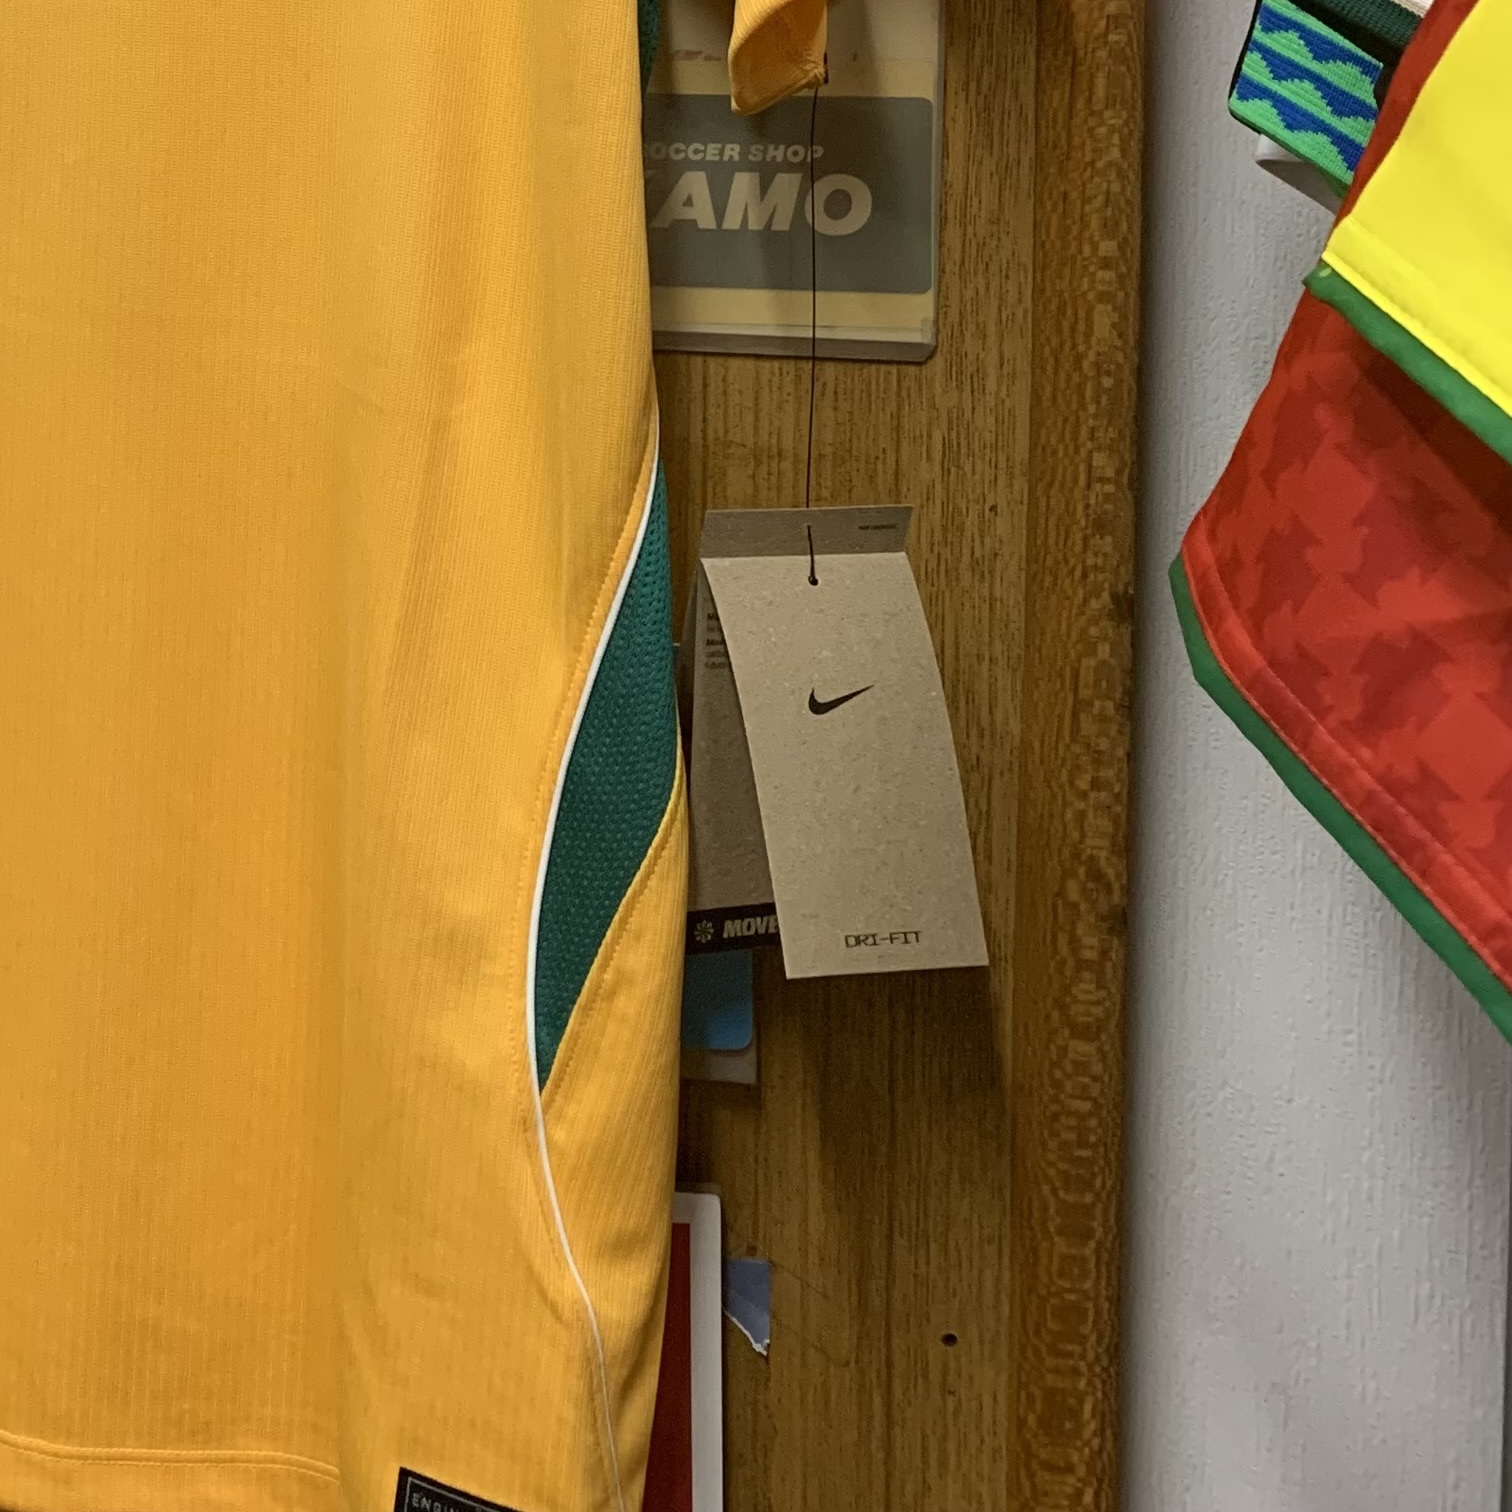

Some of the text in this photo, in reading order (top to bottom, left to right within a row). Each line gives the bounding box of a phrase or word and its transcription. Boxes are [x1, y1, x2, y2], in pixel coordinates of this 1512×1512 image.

[748, 144, 824, 163] SHOP
[647, 170, 872, 236] AMO
[723, 914, 779, 938] MOVE
[844, 930, 921, 948] DRI-FIT
